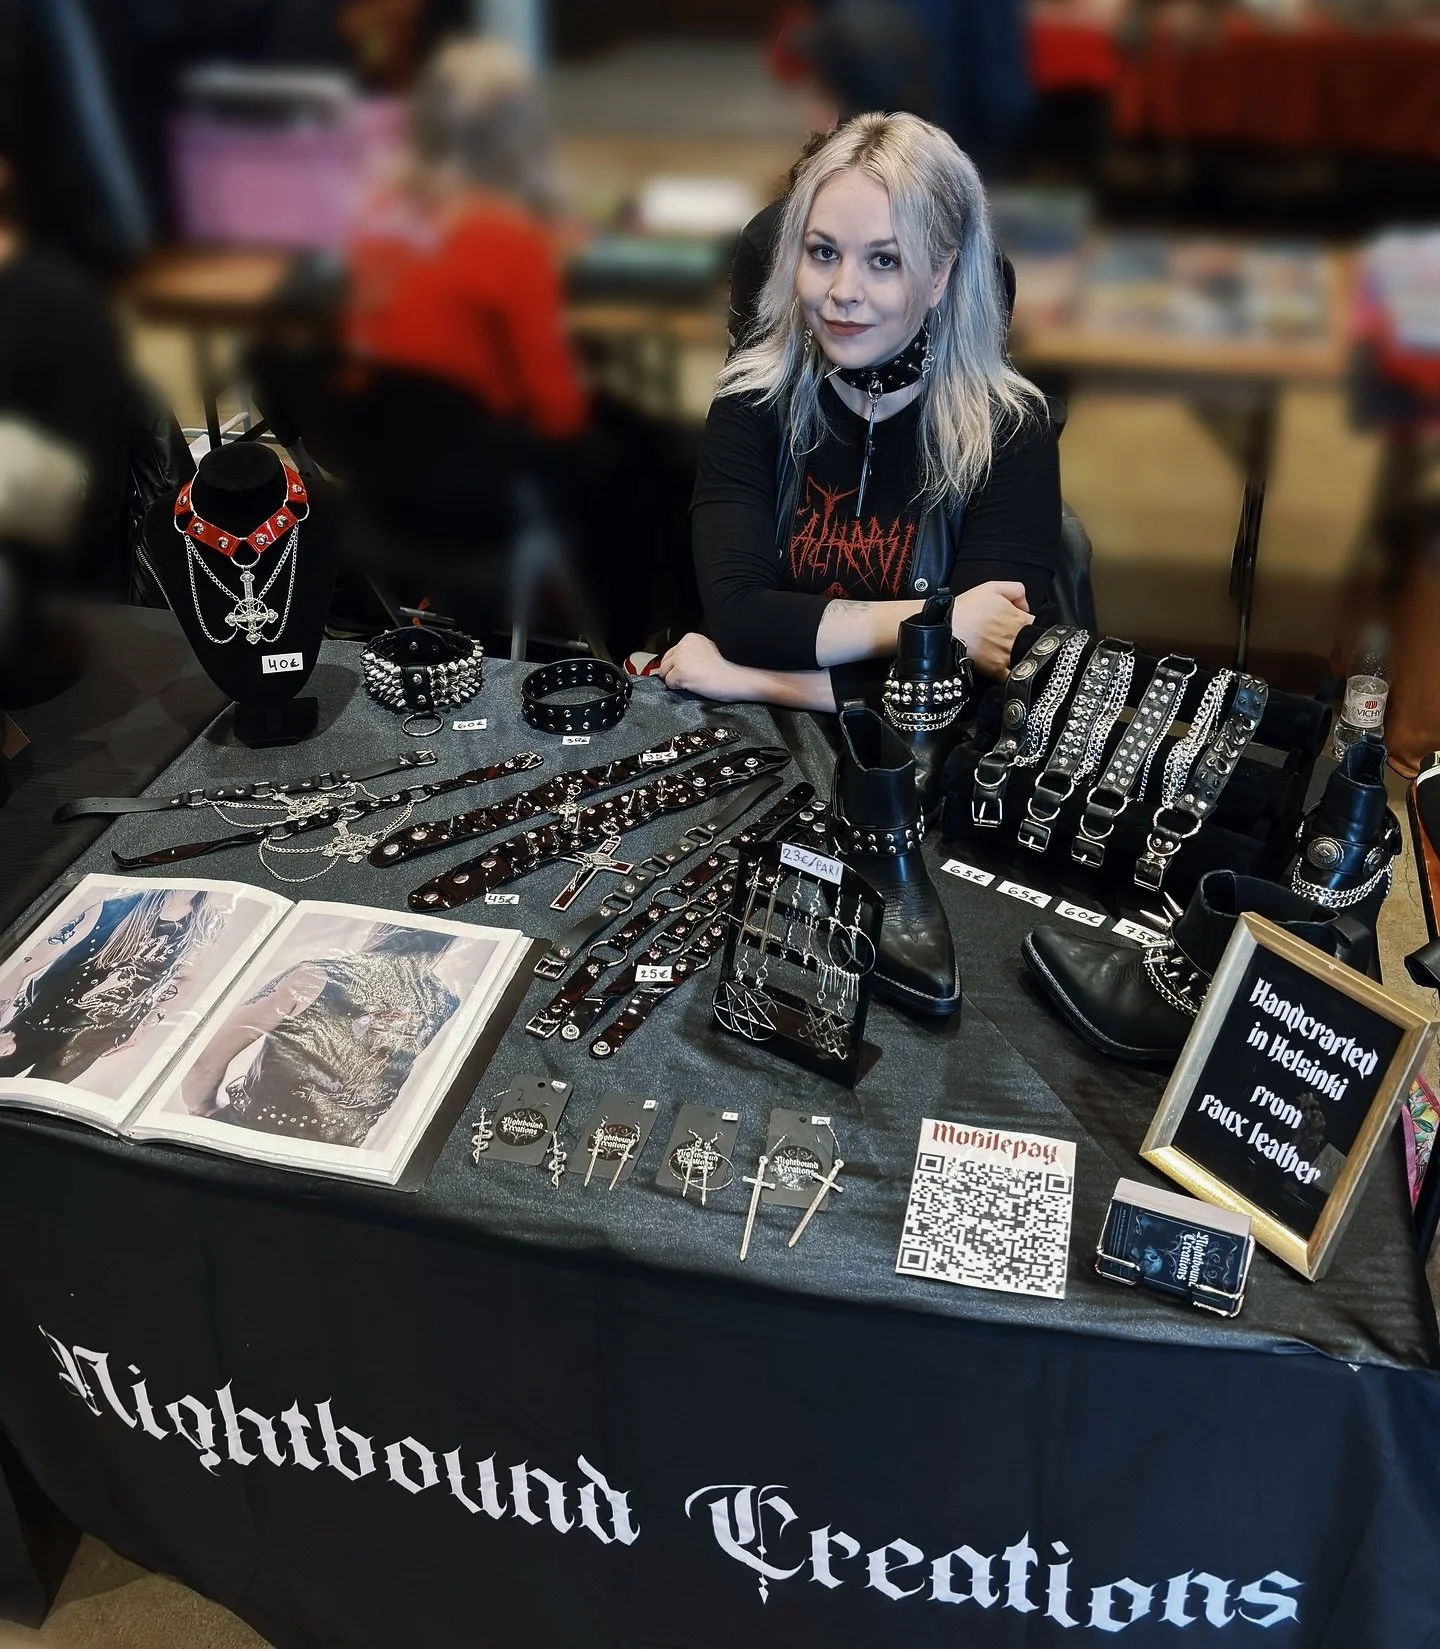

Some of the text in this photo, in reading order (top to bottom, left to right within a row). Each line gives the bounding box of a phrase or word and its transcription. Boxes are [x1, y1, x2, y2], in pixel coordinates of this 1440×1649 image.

[268, 658, 300, 671] 40€
[1357, 708, 1382, 718] VICHY
[782, 848, 840, 877] 23€/PARI
[949, 865, 986, 882] 65€
[488, 895, 516, 904] 45€
[1007, 887, 1043, 904] 65€
[1064, 907, 1101, 924] 60€
[641, 969, 669, 979] 25€
[1249, 977, 1379, 1080] Handcrafted
[1247, 1021, 1349, 1101] in Helsinki
[1250, 1085, 1303, 1129] from
[501, 1116, 544, 1129] Nightbound
[502, 1123, 538, 1135] Creations
[931, 1122, 1058, 1166] Mobilepay
[1198, 1094, 1321, 1184] faux leather
[774, 1155, 819, 1170] Nightbound
[1176, 1233, 1196, 1281] Creations
[1187, 1231, 1209, 1287] Nightboun
[38, 1325, 1307, 1633] Nightbound Creations
